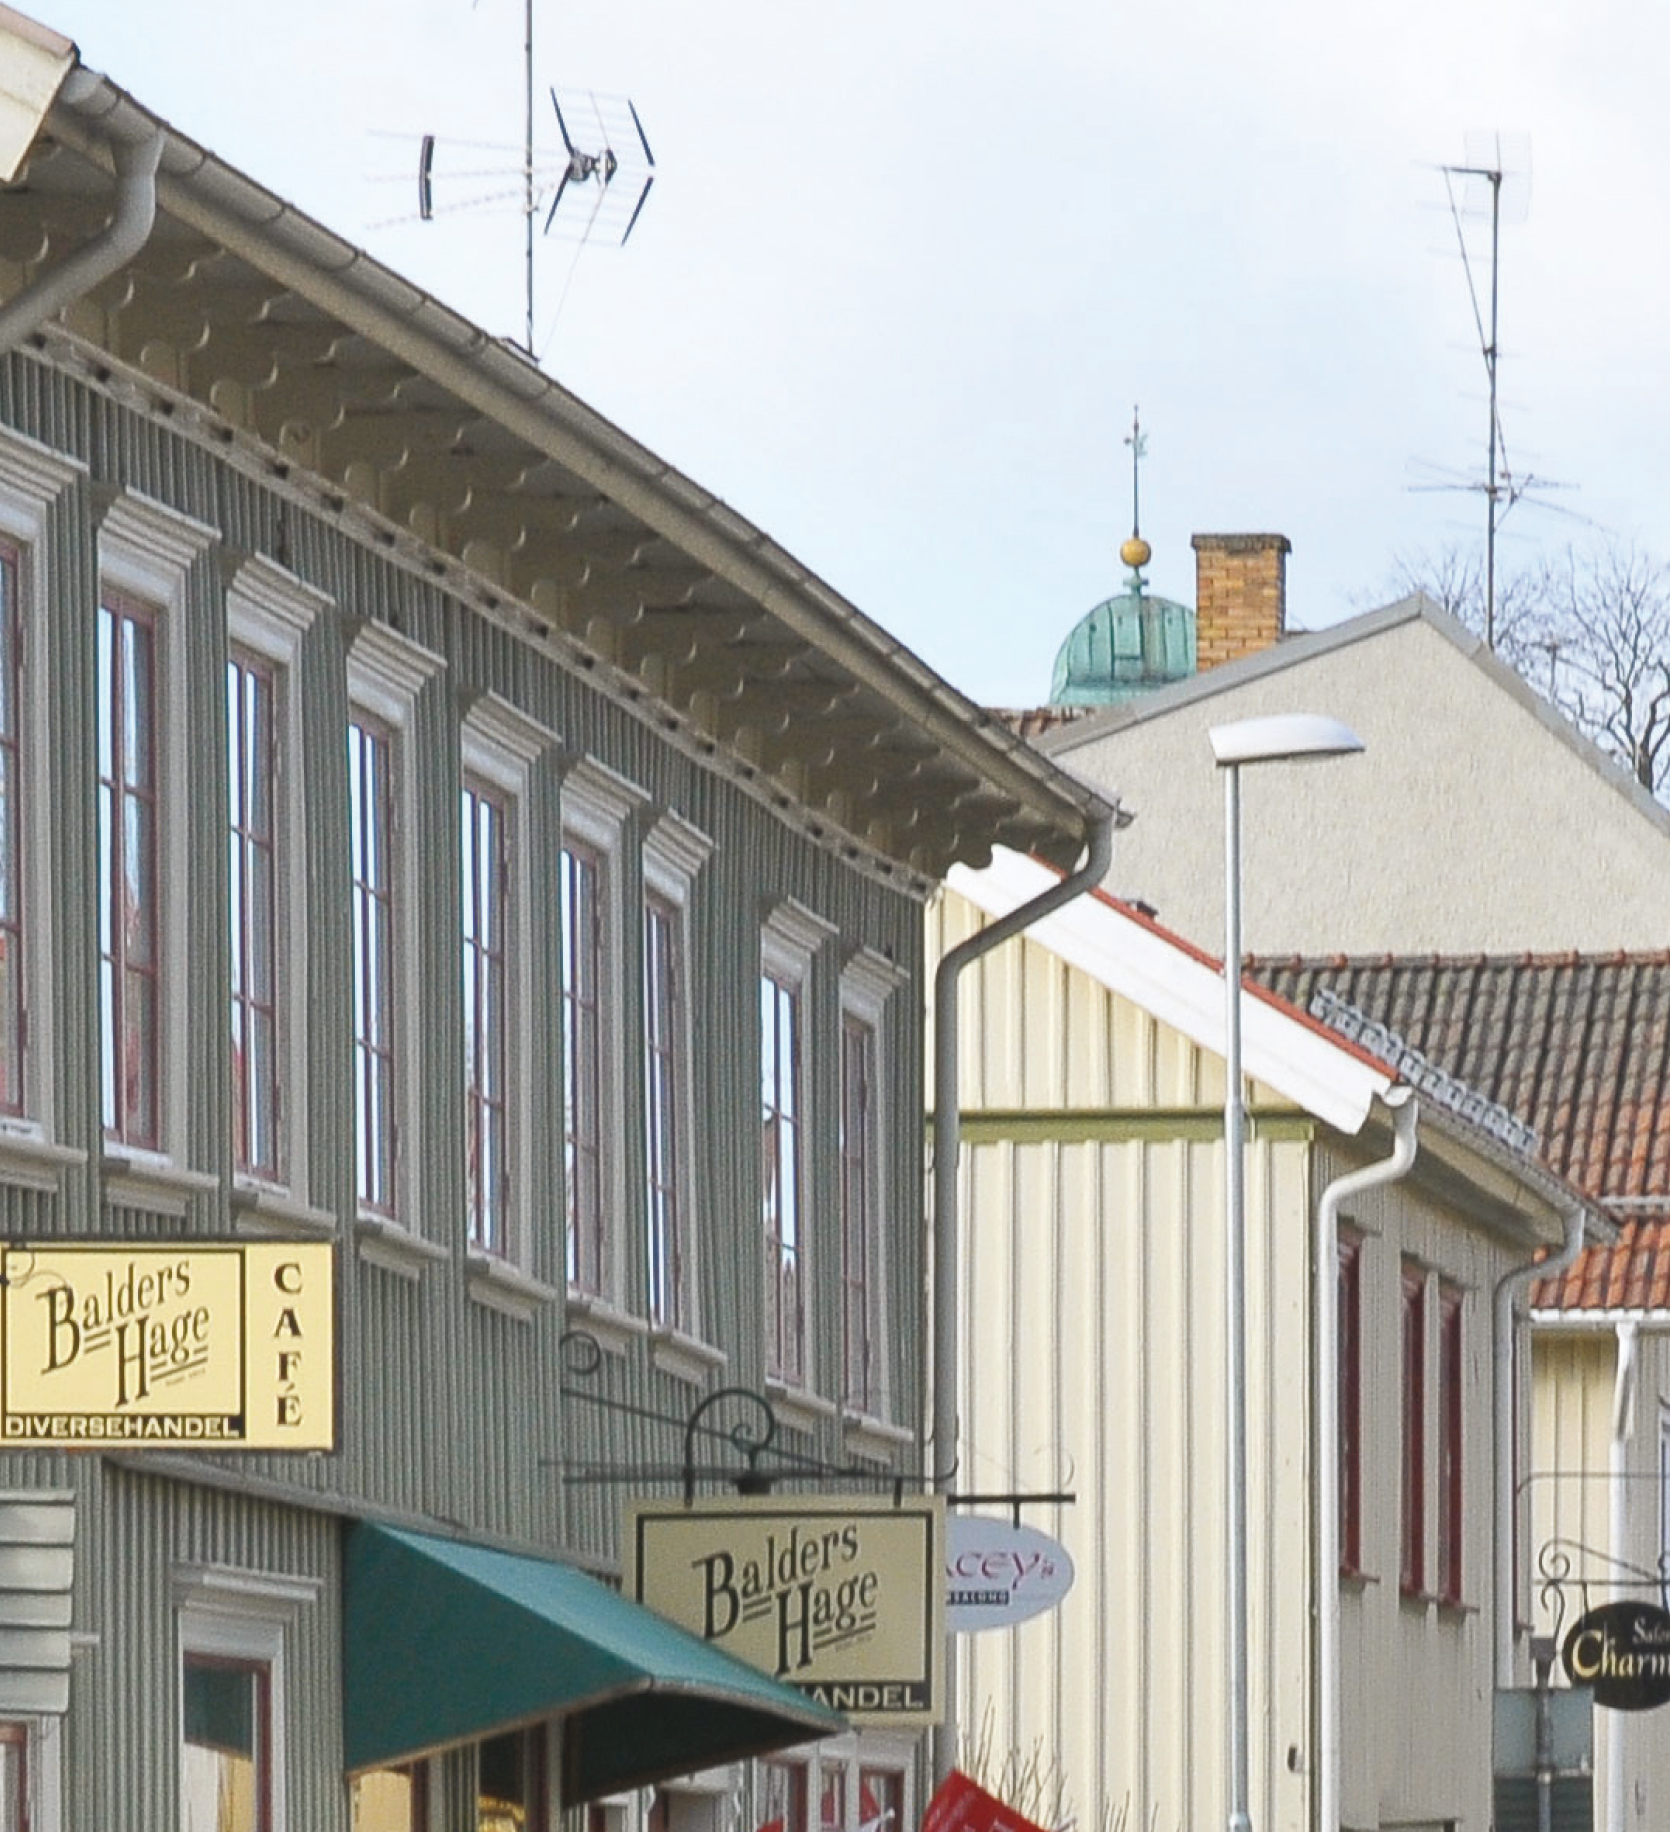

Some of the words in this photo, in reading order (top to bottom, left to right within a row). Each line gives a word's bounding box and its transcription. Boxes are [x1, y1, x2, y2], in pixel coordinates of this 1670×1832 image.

[34, 1260, 190, 1375] Balders
[114, 1305, 209, 1408] Hage
[273, 1263, 303, 1427] CAFÉ
[6, 1416, 240, 1438] DIVERSEHANDEL
[692, 1524, 858, 1642] Balders
[775, 1568, 878, 1677] Hage
